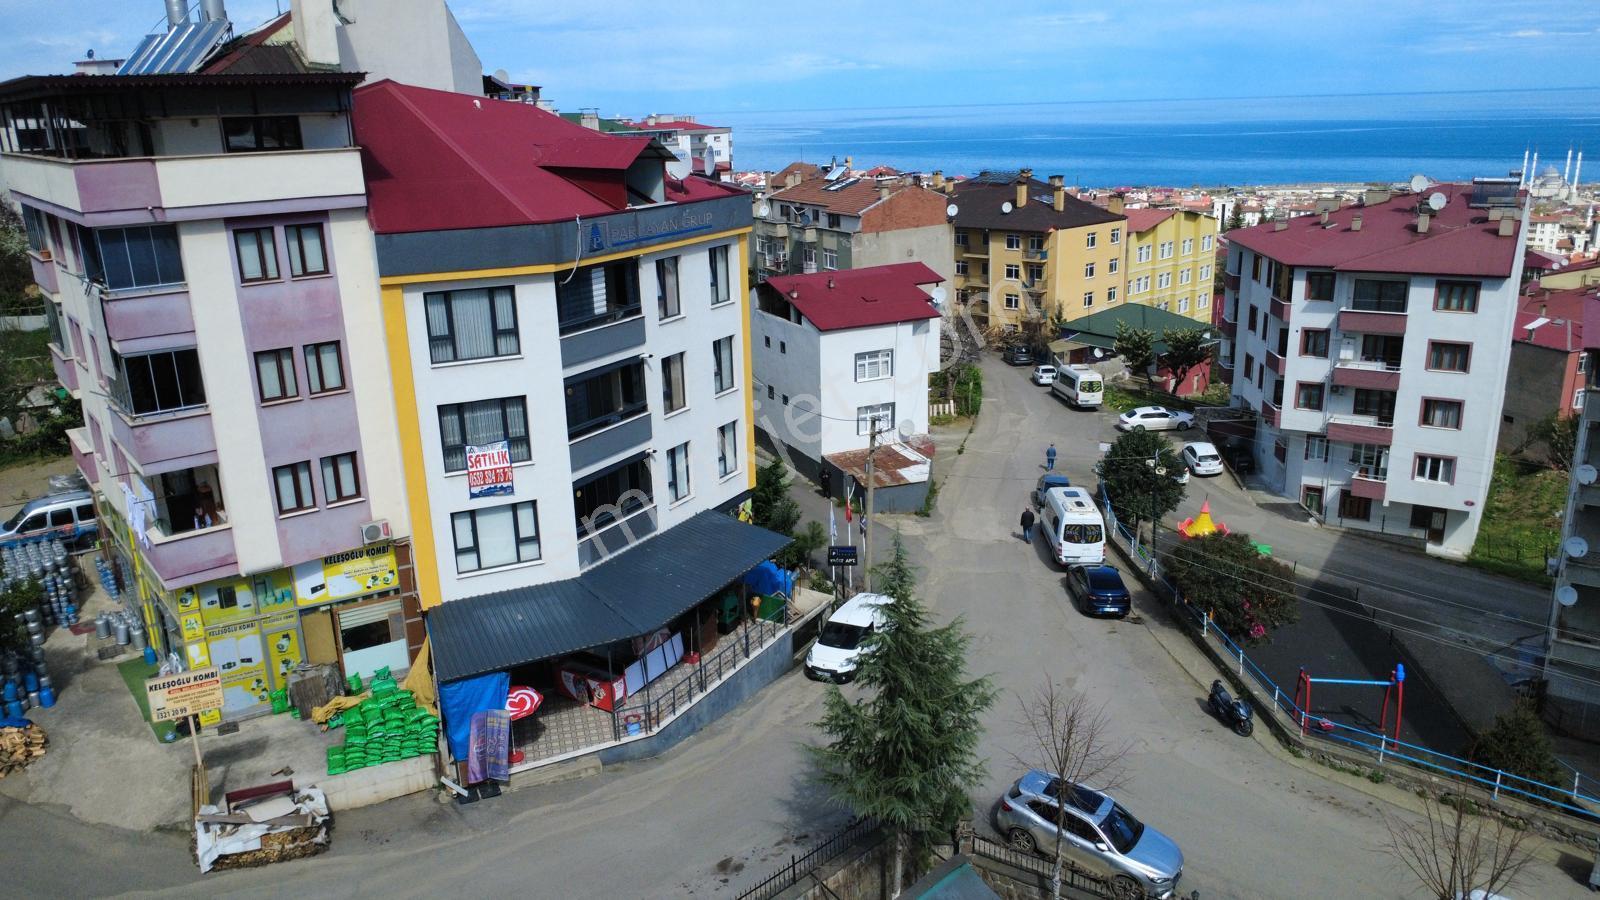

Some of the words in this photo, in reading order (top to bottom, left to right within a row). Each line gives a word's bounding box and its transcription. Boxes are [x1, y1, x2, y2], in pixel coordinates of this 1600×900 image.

[682, 212, 713, 227] GRUP
[467, 451, 509, 469] SATILIK
[148, 677, 191, 693] KELEŞOĞLU
